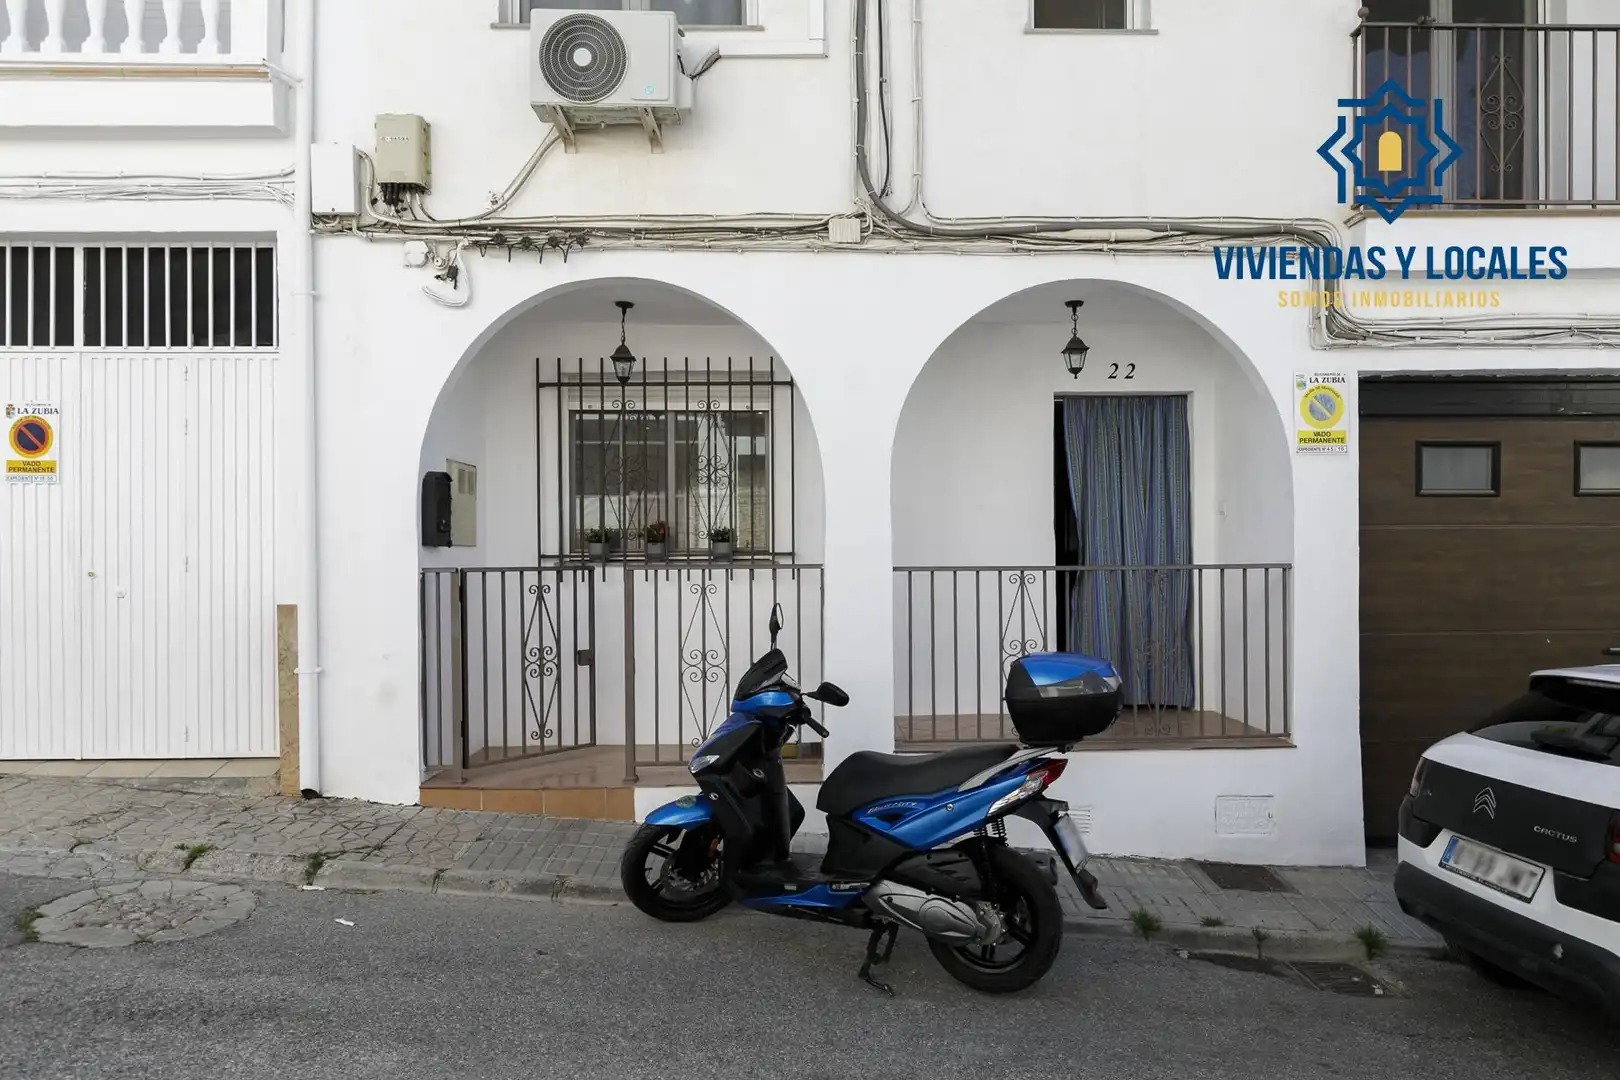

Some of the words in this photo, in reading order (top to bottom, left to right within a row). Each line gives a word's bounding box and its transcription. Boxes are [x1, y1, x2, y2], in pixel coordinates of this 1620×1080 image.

[1309, 376, 1319, 384] LA
[1321, 376, 1346, 384] ZUBIA
[17, 407, 29, 415] LA
[31, 407, 60, 415] ZUBIA
[1533, 825, 1578, 843] CACTUS
